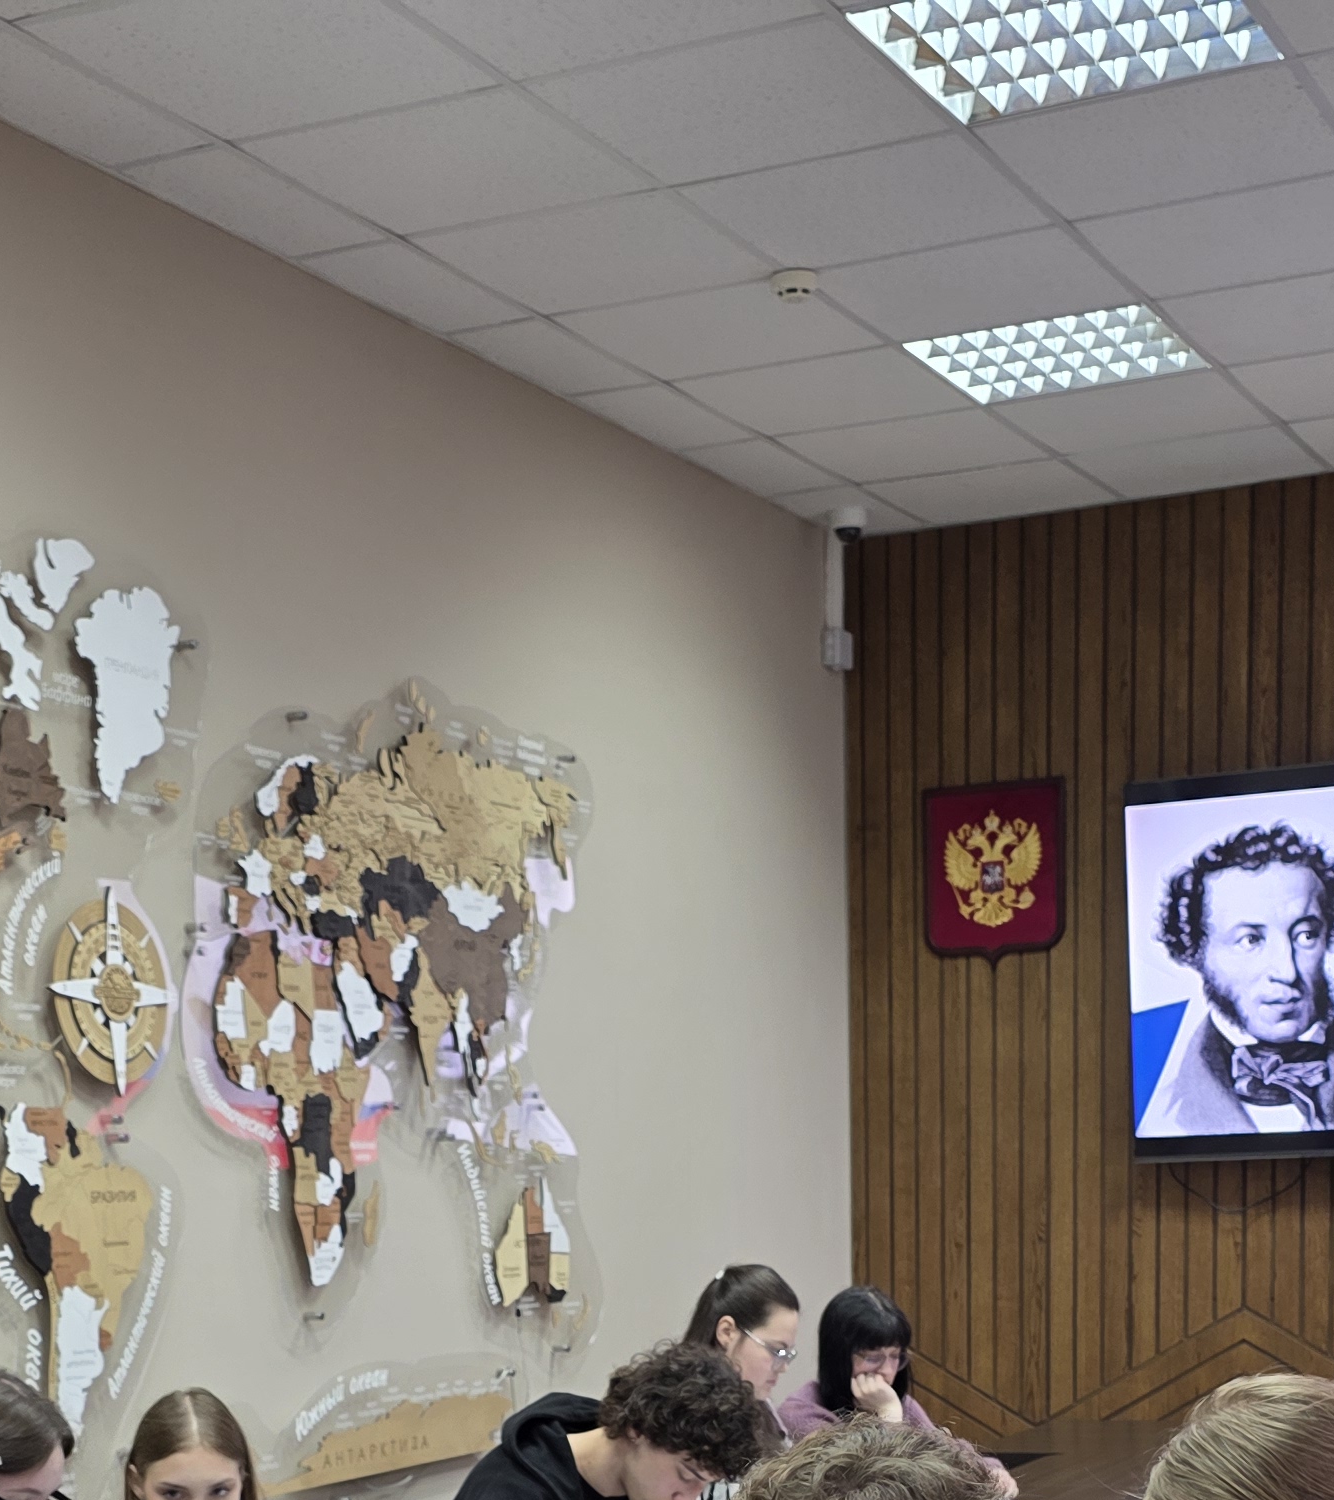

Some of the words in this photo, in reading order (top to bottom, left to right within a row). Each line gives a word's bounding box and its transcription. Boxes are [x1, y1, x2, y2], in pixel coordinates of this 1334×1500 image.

[23, 903, 48, 967] океан
[481, 1251, 502, 1306] океан
[24, 1328, 43, 1392] оке
[294, 1375, 344, 1442] Южный
[349, 1369, 390, 1395] океан
[322, 1435, 430, 1470] АНТАРКТИДА
